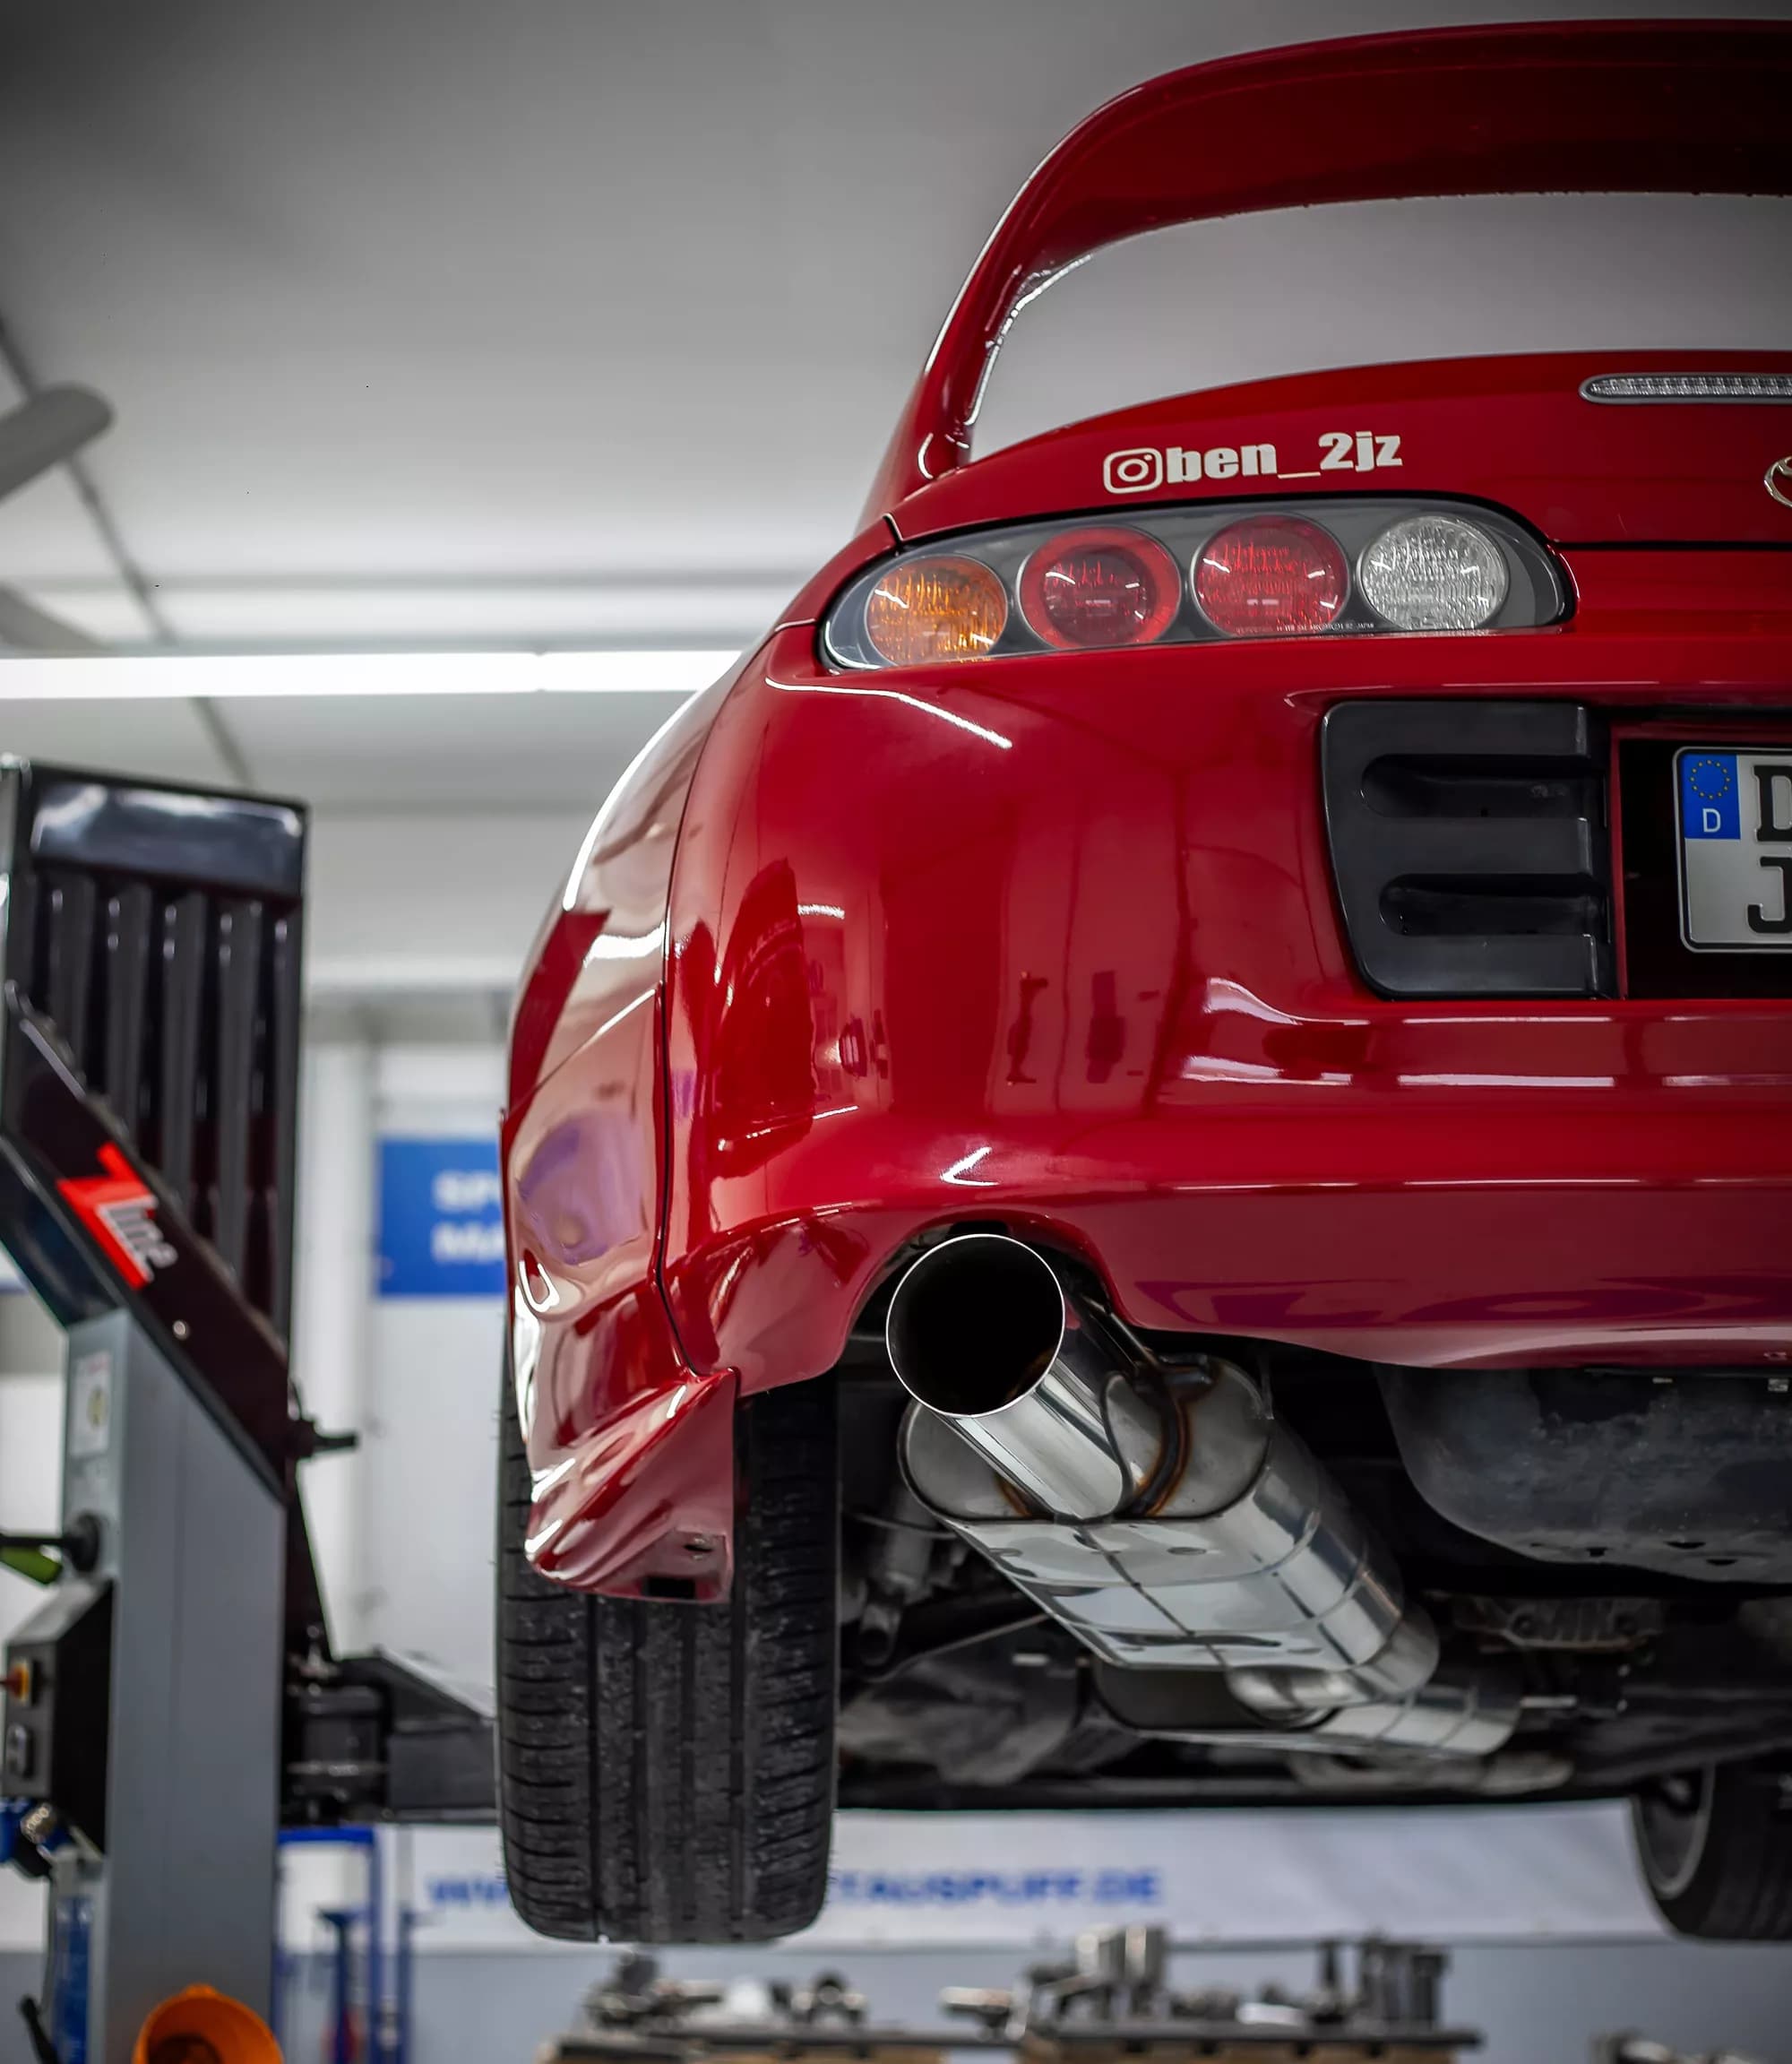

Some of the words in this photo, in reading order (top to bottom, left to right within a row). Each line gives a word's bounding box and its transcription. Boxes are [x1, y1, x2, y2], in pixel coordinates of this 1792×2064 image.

[1702, 807, 1721, 833] D
[1747, 856, 1792, 934] J
[432, 1169, 502, 1212] SP
